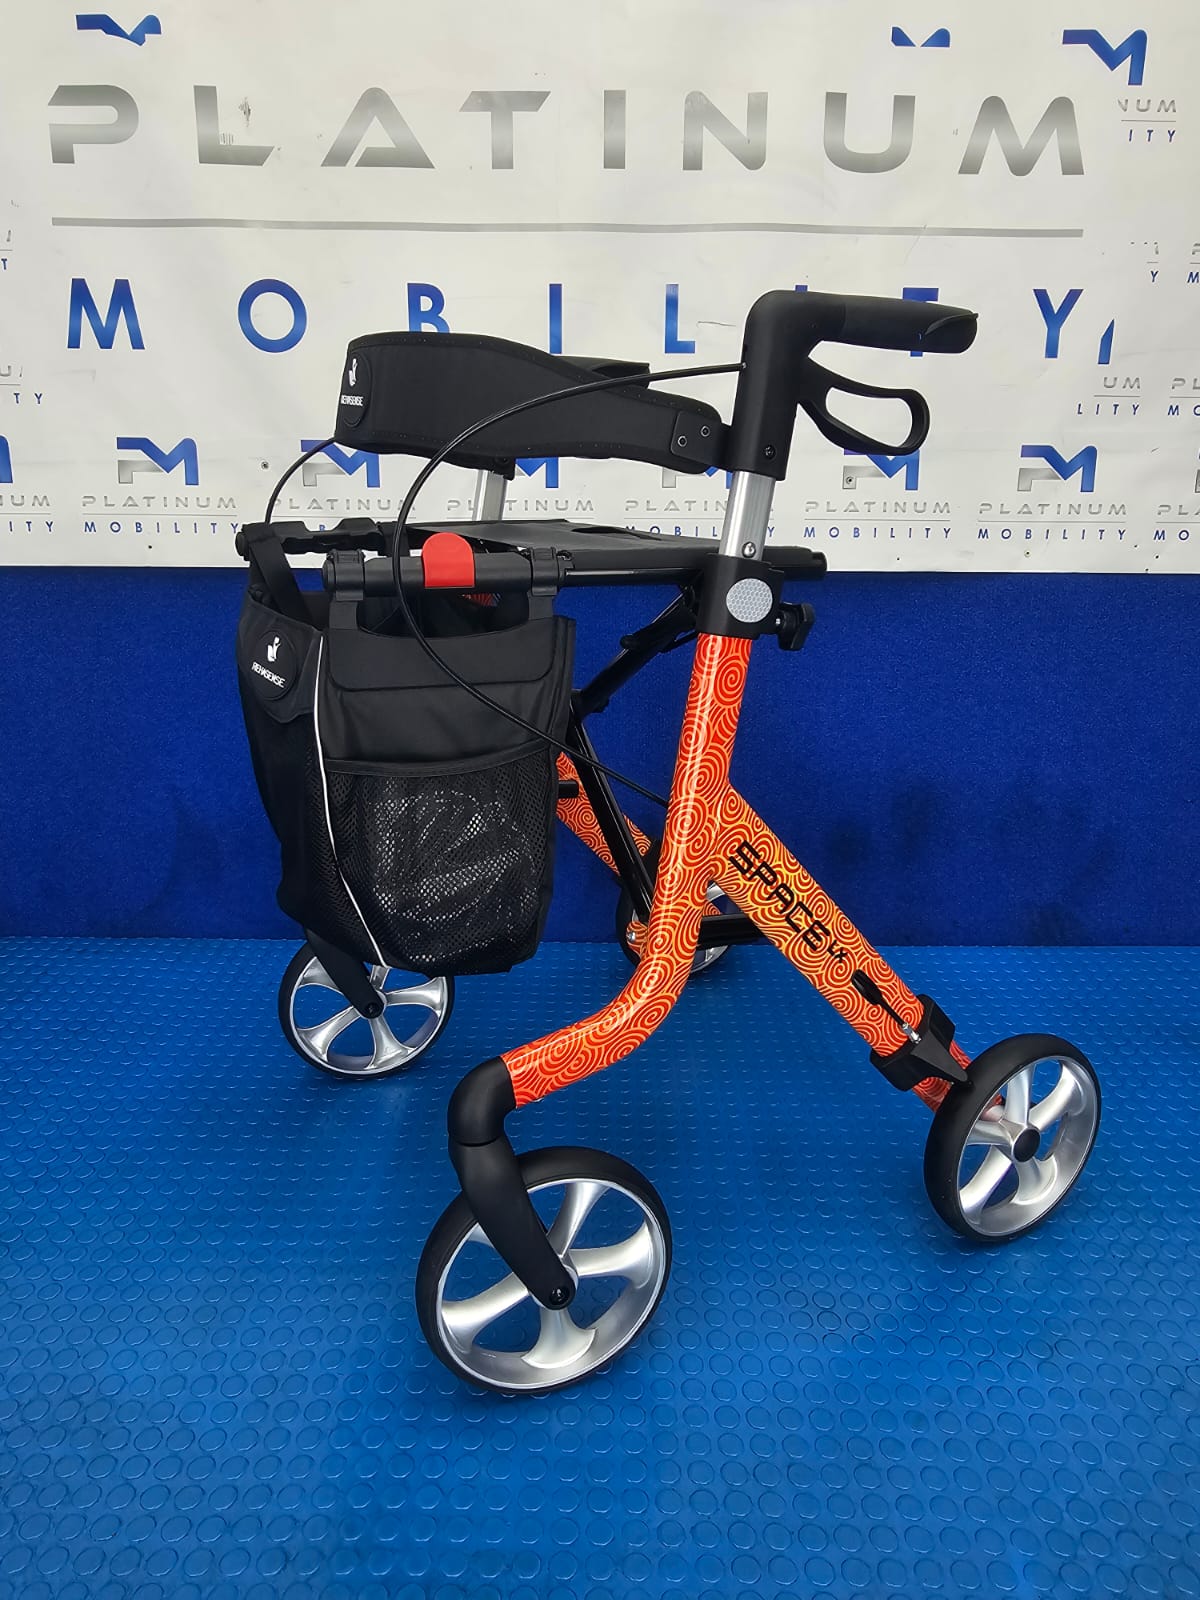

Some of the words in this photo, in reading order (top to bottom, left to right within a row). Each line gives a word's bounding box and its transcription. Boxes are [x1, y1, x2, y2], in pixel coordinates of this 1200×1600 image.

[48, 85, 1084, 177] PLATINUM
[67, 278, 1084, 358] MOBILTY
[82, 495, 237, 509] PLATINUM
[447, 500, 594, 512] PLTINUM
[625, 500, 774, 512] PLATIN
[805, 501, 951, 514] PLATINUM
[979, 503, 1127, 516] PLATINUM
[84, 521, 239, 534] MOBILITY
[803, 526, 952, 539] MOBILITY
[977, 528, 1127, 541] MOBILITY
[729, 840, 831, 951] SPACE
